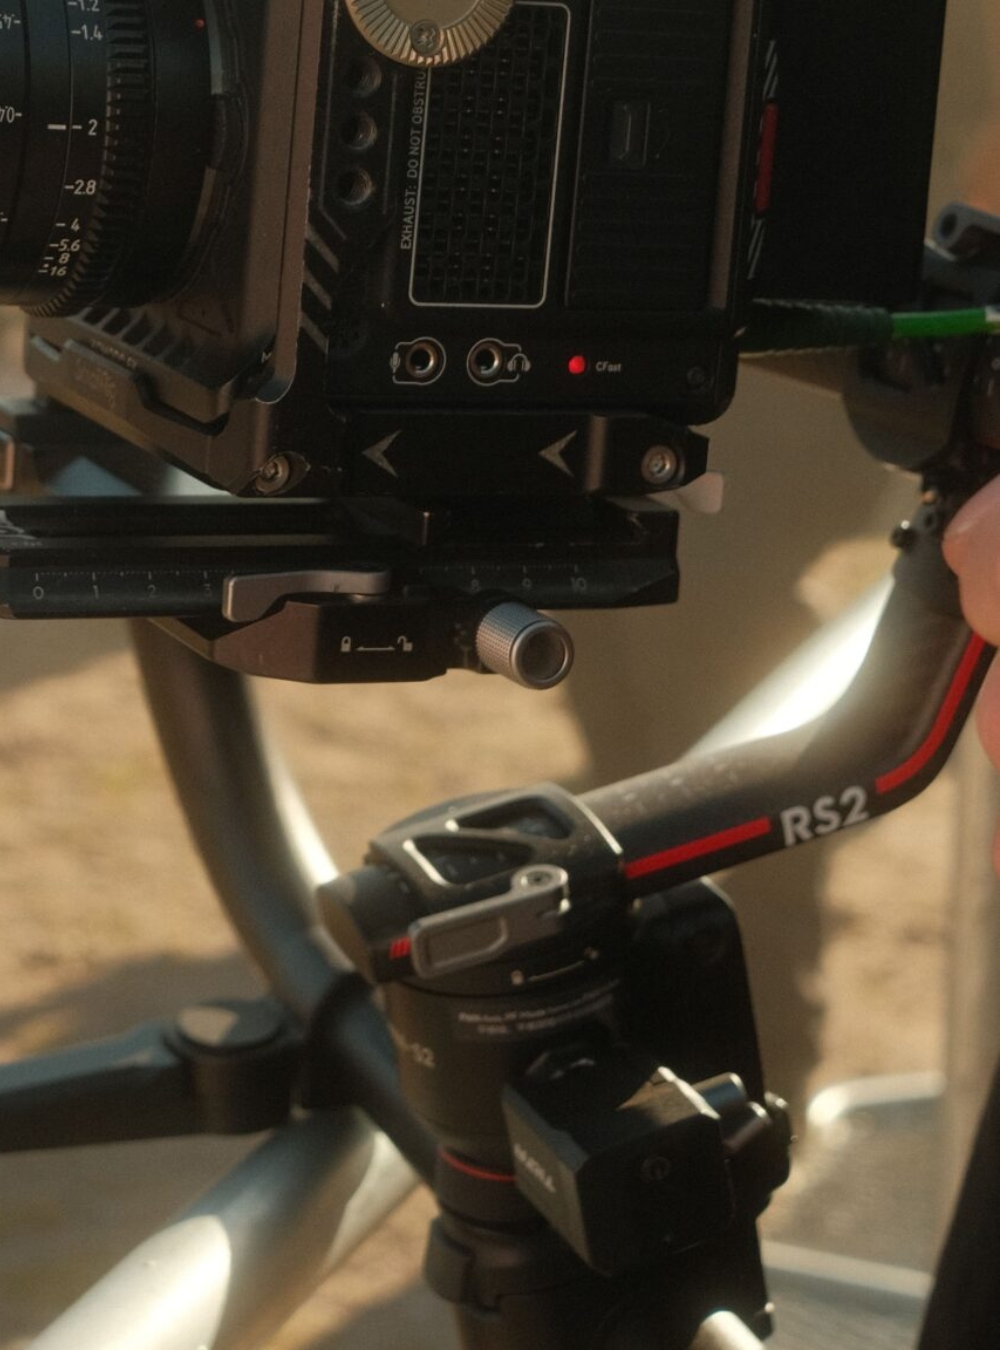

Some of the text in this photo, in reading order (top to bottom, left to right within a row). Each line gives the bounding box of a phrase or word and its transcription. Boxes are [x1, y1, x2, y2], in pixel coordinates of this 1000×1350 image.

[81, 24, 103, 41] 1.4
[88, 119, 98, 136] 2
[401, 68, 426, 250] EXHAUST: DO NOT OBSTRU
[74, 180, 97, 195] 2.8
[70, 217, 80, 232] 4
[58, 238, 80, 252] 5.6
[58, 252, 71, 264] 8
[32, 586, 44, 600] 0
[92, 585, 100, 599] 1
[147, 584, 157, 598] 2
[780, 786, 869, 847] RS2
